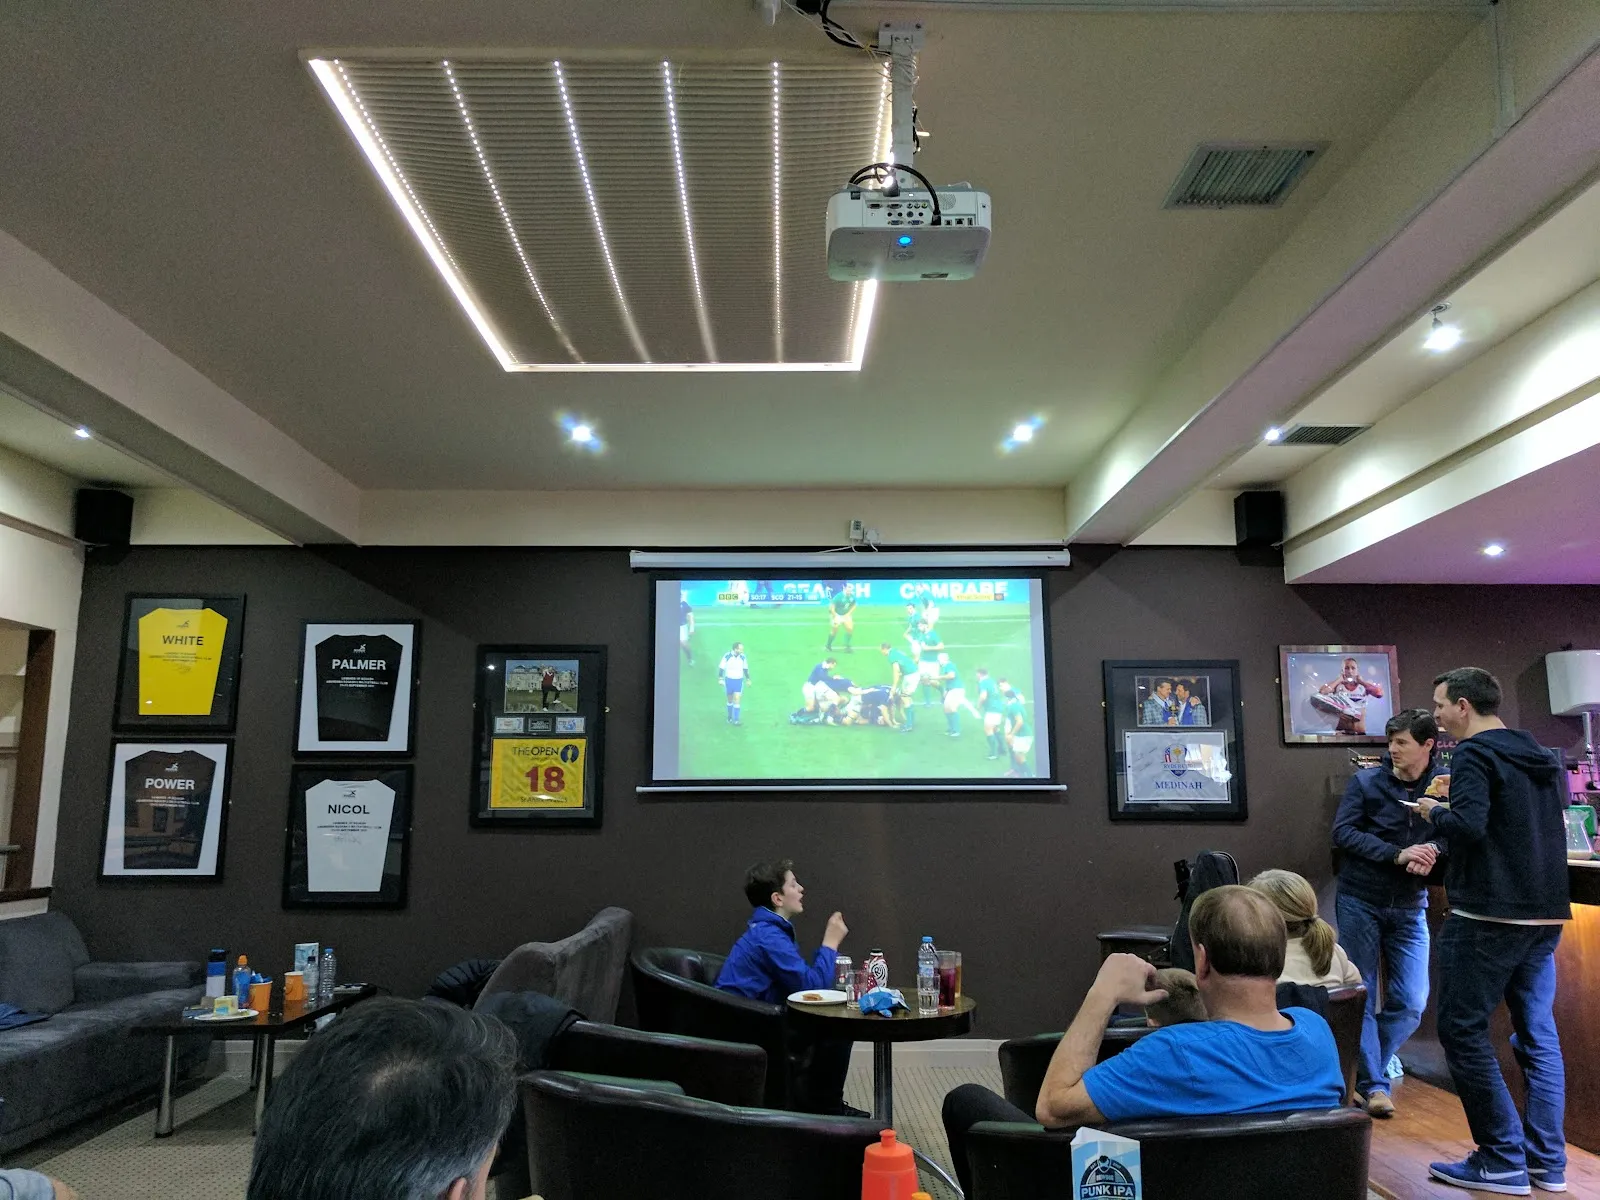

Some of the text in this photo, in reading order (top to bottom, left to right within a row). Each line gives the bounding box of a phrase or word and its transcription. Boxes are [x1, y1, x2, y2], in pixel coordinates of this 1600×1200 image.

[162, 635, 204, 646] WHITE
[332, 659, 386, 670] PALMER
[145, 778, 195, 790] POWER
[525, 766, 565, 793] 18
[1155, 781, 1203, 790] MEDINAH
[328, 804, 370, 814] NICOL
[1081, 1185, 1134, 1198] PUNK IPA
